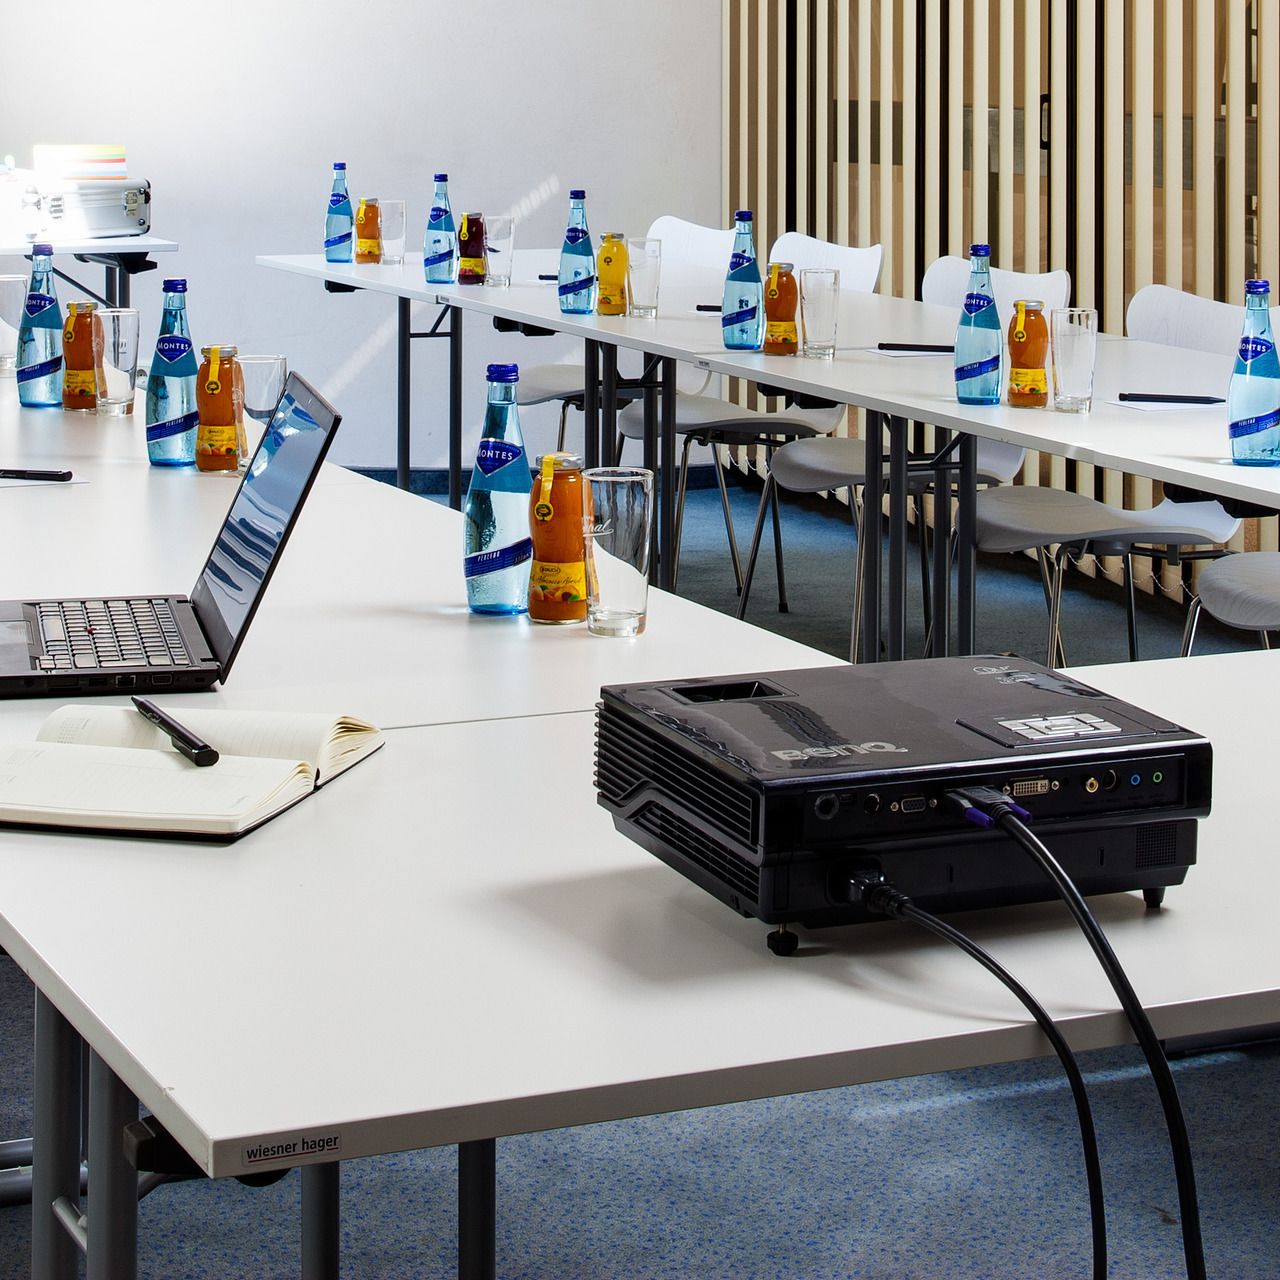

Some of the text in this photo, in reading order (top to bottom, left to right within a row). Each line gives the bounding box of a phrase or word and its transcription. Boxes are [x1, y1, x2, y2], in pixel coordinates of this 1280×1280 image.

[27, 299, 50, 307] ONTES
[966, 298, 988, 307] ONTES
[1240, 342, 1267, 353] ONTES
[771, 741, 909, 762] BenQ
[246, 1135, 339, 1159] wiesner hager
